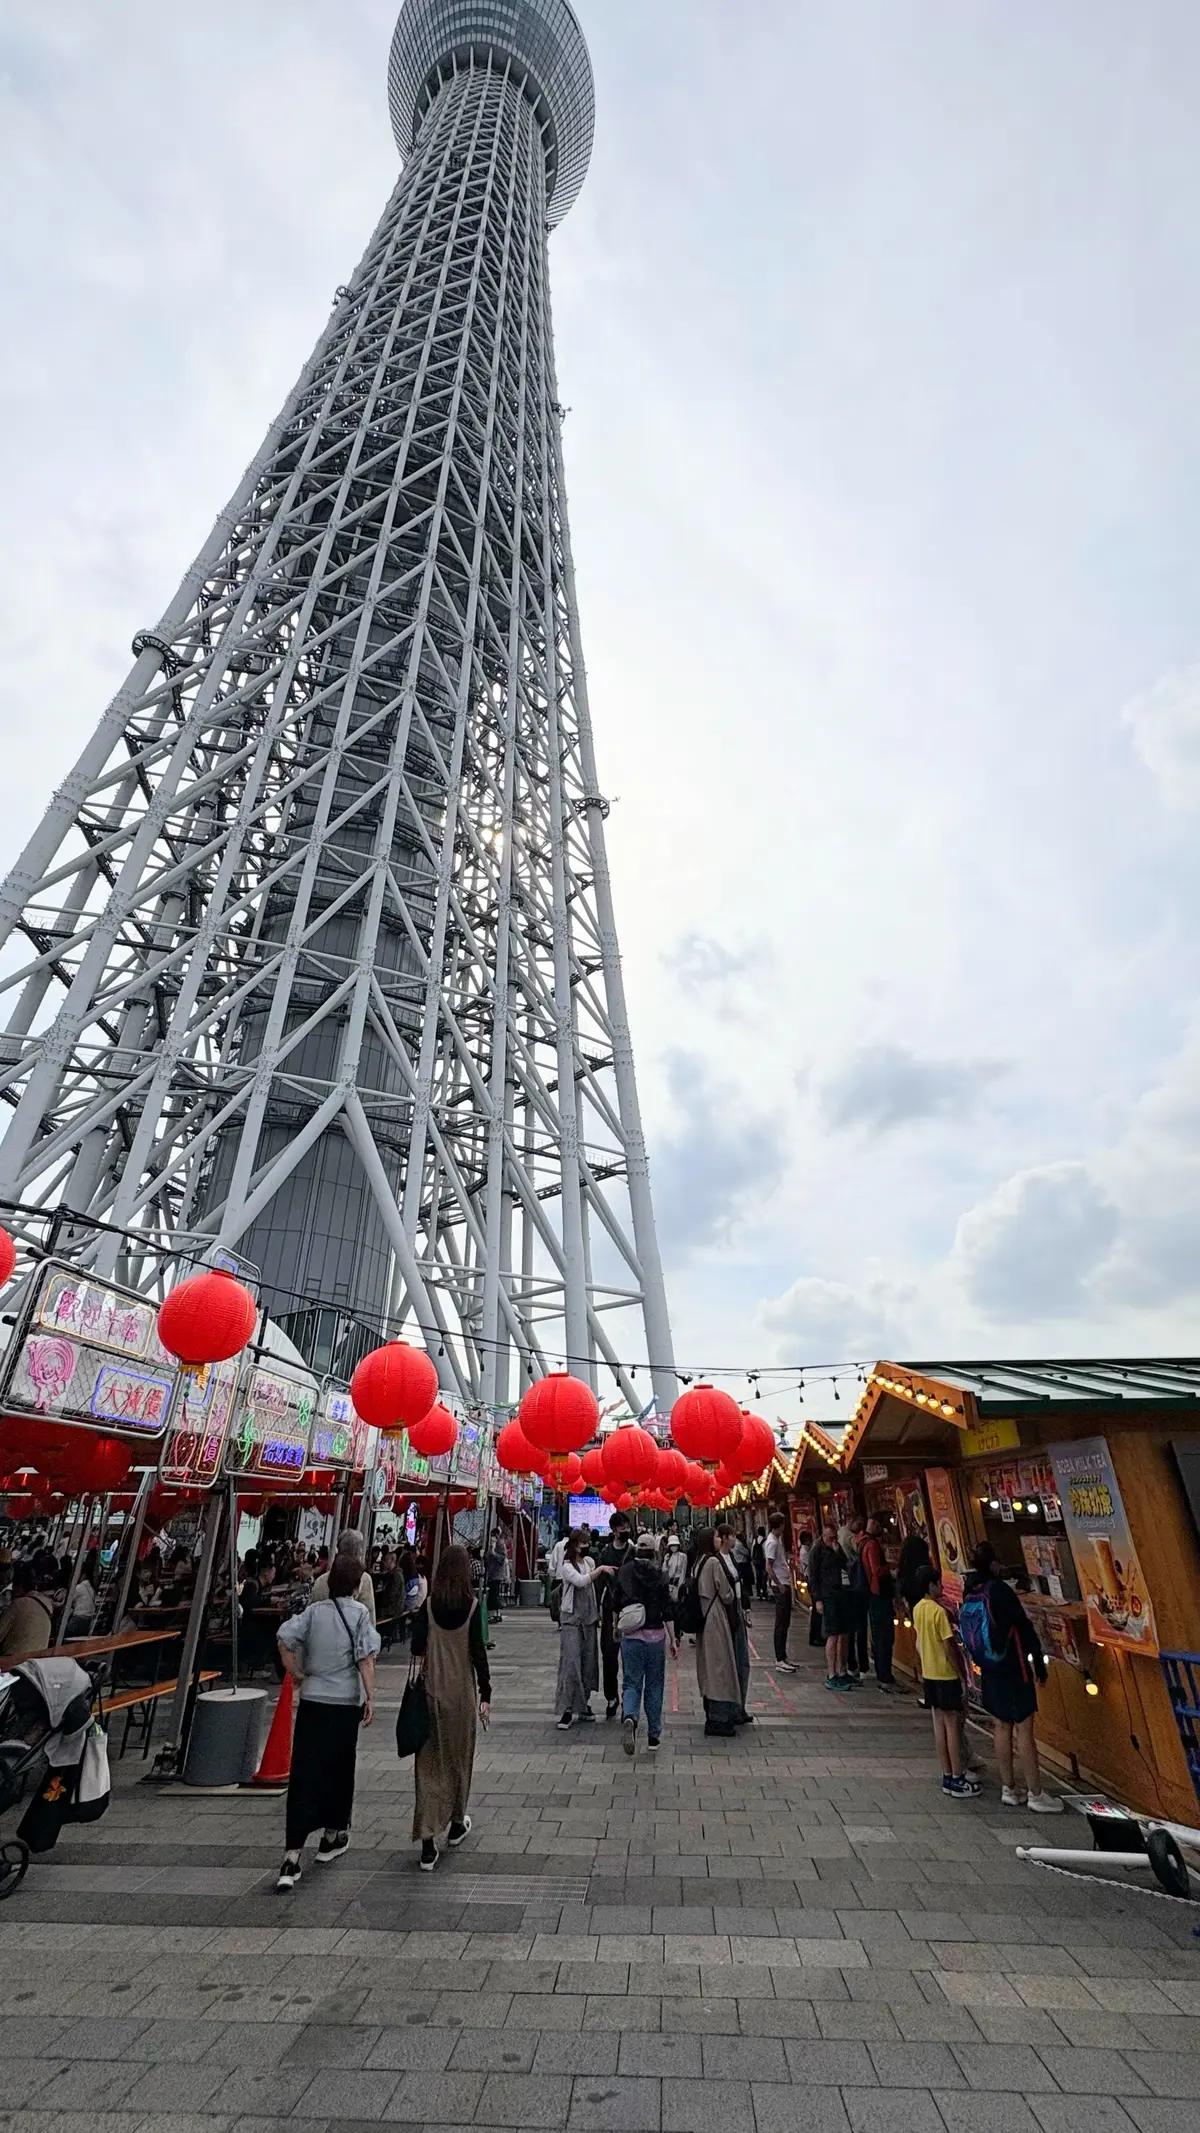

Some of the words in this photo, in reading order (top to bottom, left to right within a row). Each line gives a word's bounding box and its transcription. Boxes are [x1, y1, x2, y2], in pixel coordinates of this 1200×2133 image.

[101, 1381, 164, 1420] 大減價
[1056, 1457, 1076, 1474] BOBA
[1075, 1455, 1093, 1472] MILK
[1091, 1452, 1108, 1469] TEA
